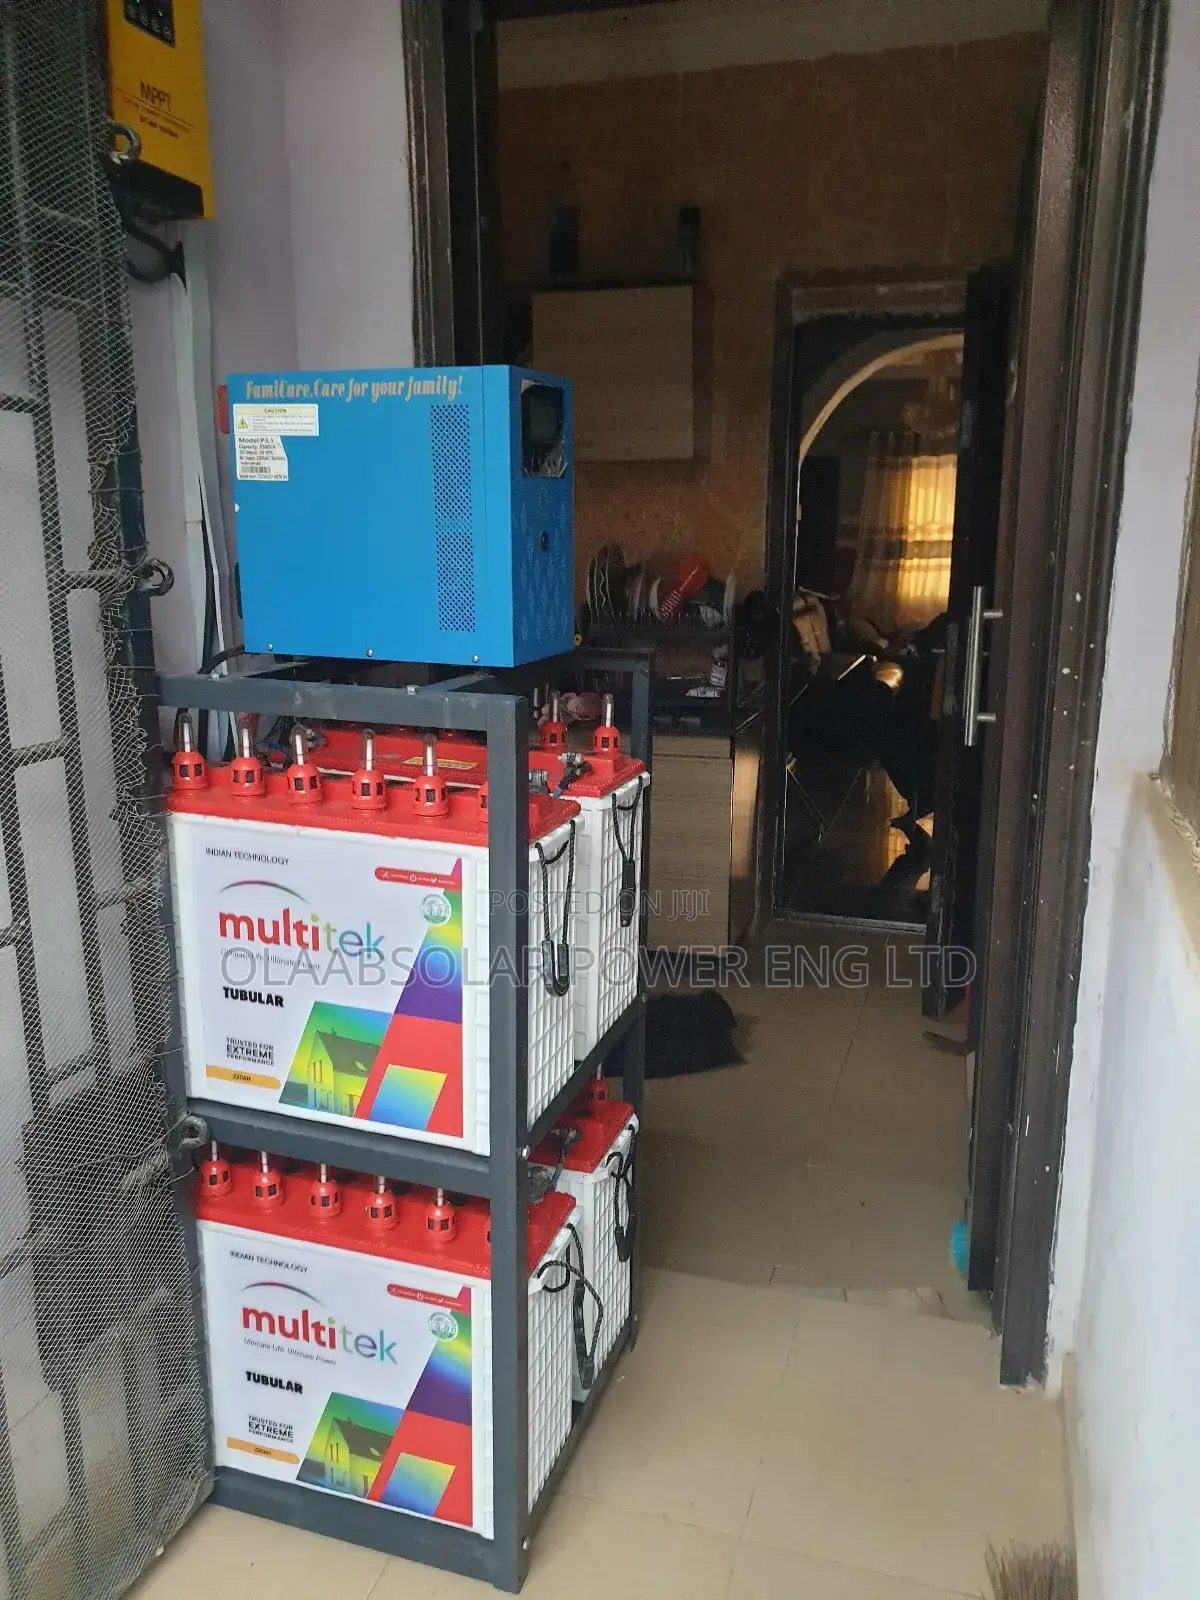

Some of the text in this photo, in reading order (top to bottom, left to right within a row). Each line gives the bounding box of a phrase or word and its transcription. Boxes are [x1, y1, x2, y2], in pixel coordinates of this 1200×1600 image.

[345, 378, 369, 402] for
[371, 379, 406, 403] your
[405, 373, 463, 402] family!
[205, 846, 290, 866] INDIAN TECHNOLOGY
[218, 907, 386, 961] multitek
[222, 986, 284, 1008] TUBULAR
[226, 1037, 274, 1051] TRUSTED FOR
[226, 1044, 274, 1060] EXTREME
[226, 1053, 275, 1066] PERFORMANCE
[229, 1250, 308, 1274] INDIAN TECHNOLOGY
[241, 1306, 398, 1365] multitek
[287, 1347, 315, 1361] Ultimate
[245, 1370, 303, 1394] TUBULAR
[247, 1414, 293, 1431] TRUSTED FOR
[248, 1421, 294, 1439] EXTREME
[248, 1428, 294, 1444] PERFORMANCE
